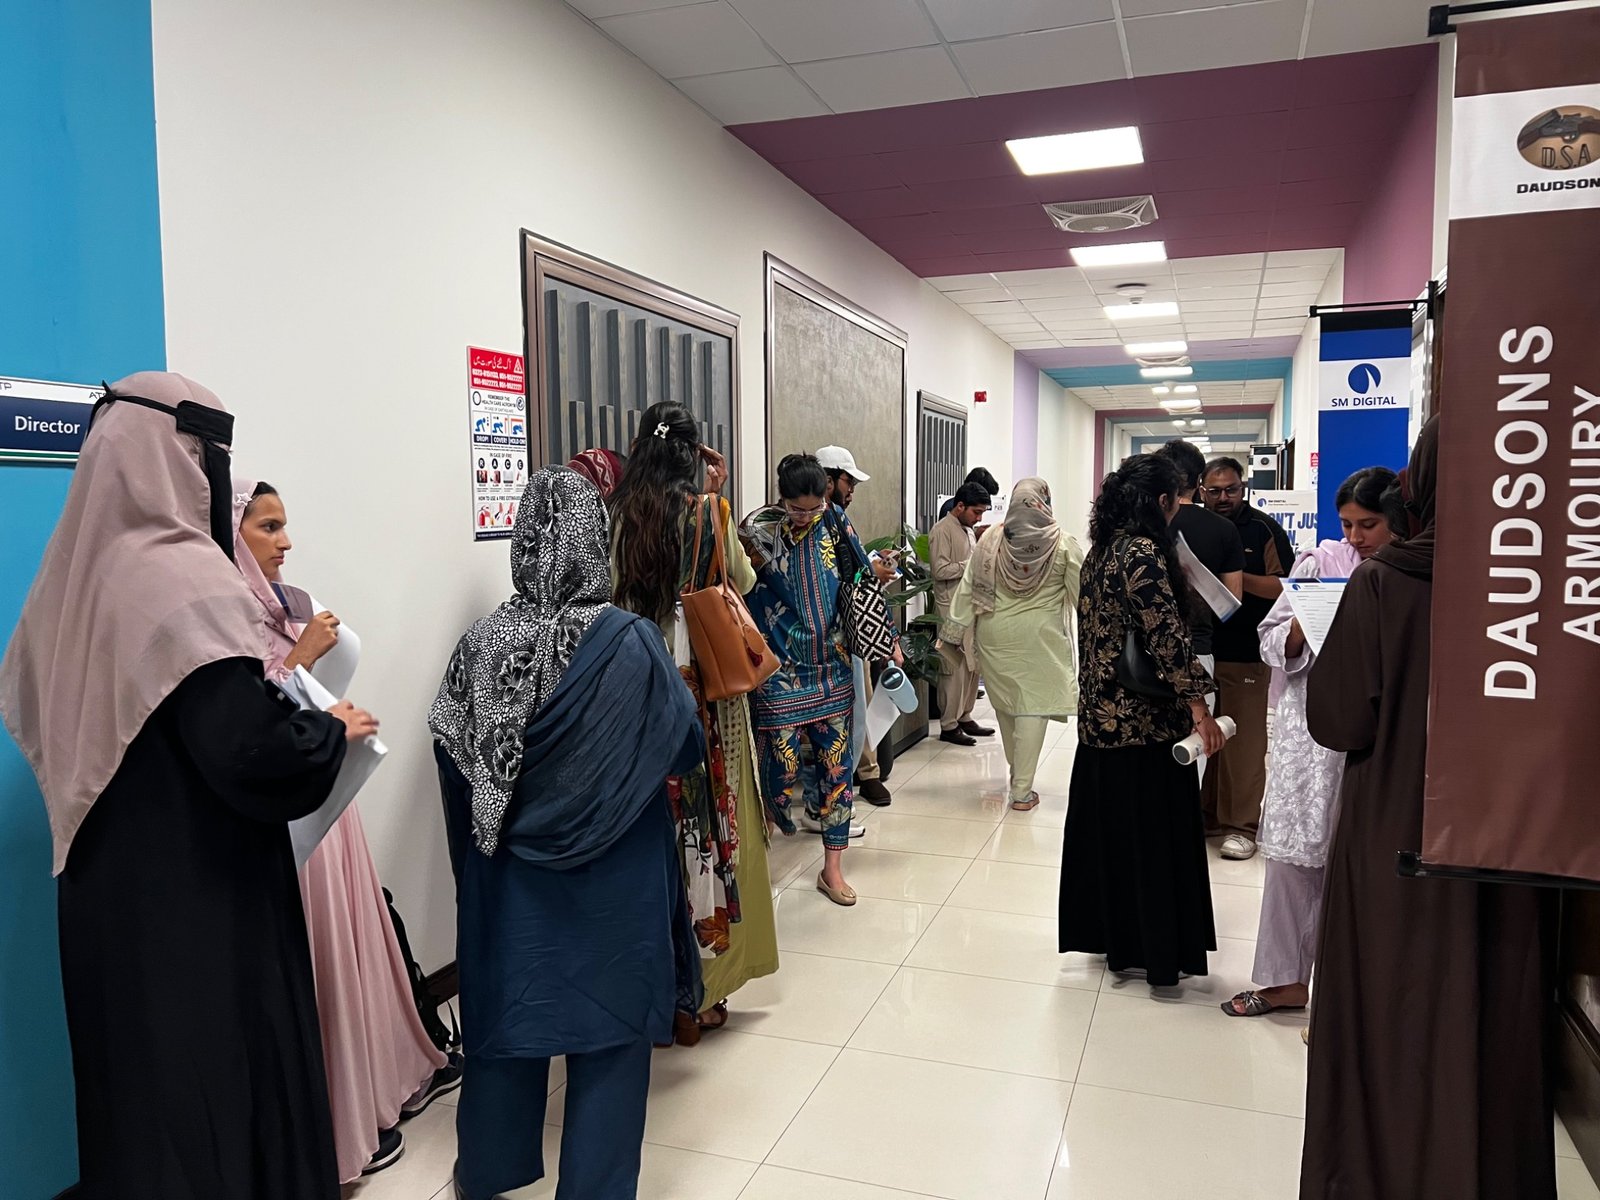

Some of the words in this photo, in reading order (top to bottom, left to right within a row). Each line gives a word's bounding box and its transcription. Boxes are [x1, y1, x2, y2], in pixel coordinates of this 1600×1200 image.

[1517, 178, 1600, 194] DAUDSON
[0, 382, 12, 390] TP
[1331, 398, 1349, 407] SM
[1353, 396, 1397, 406] DIGITAL
[15, 415, 81, 434] Director
[1484, 325, 1554, 700] DAUDSONS
[1563, 385, 1600, 645] ARMOURY
